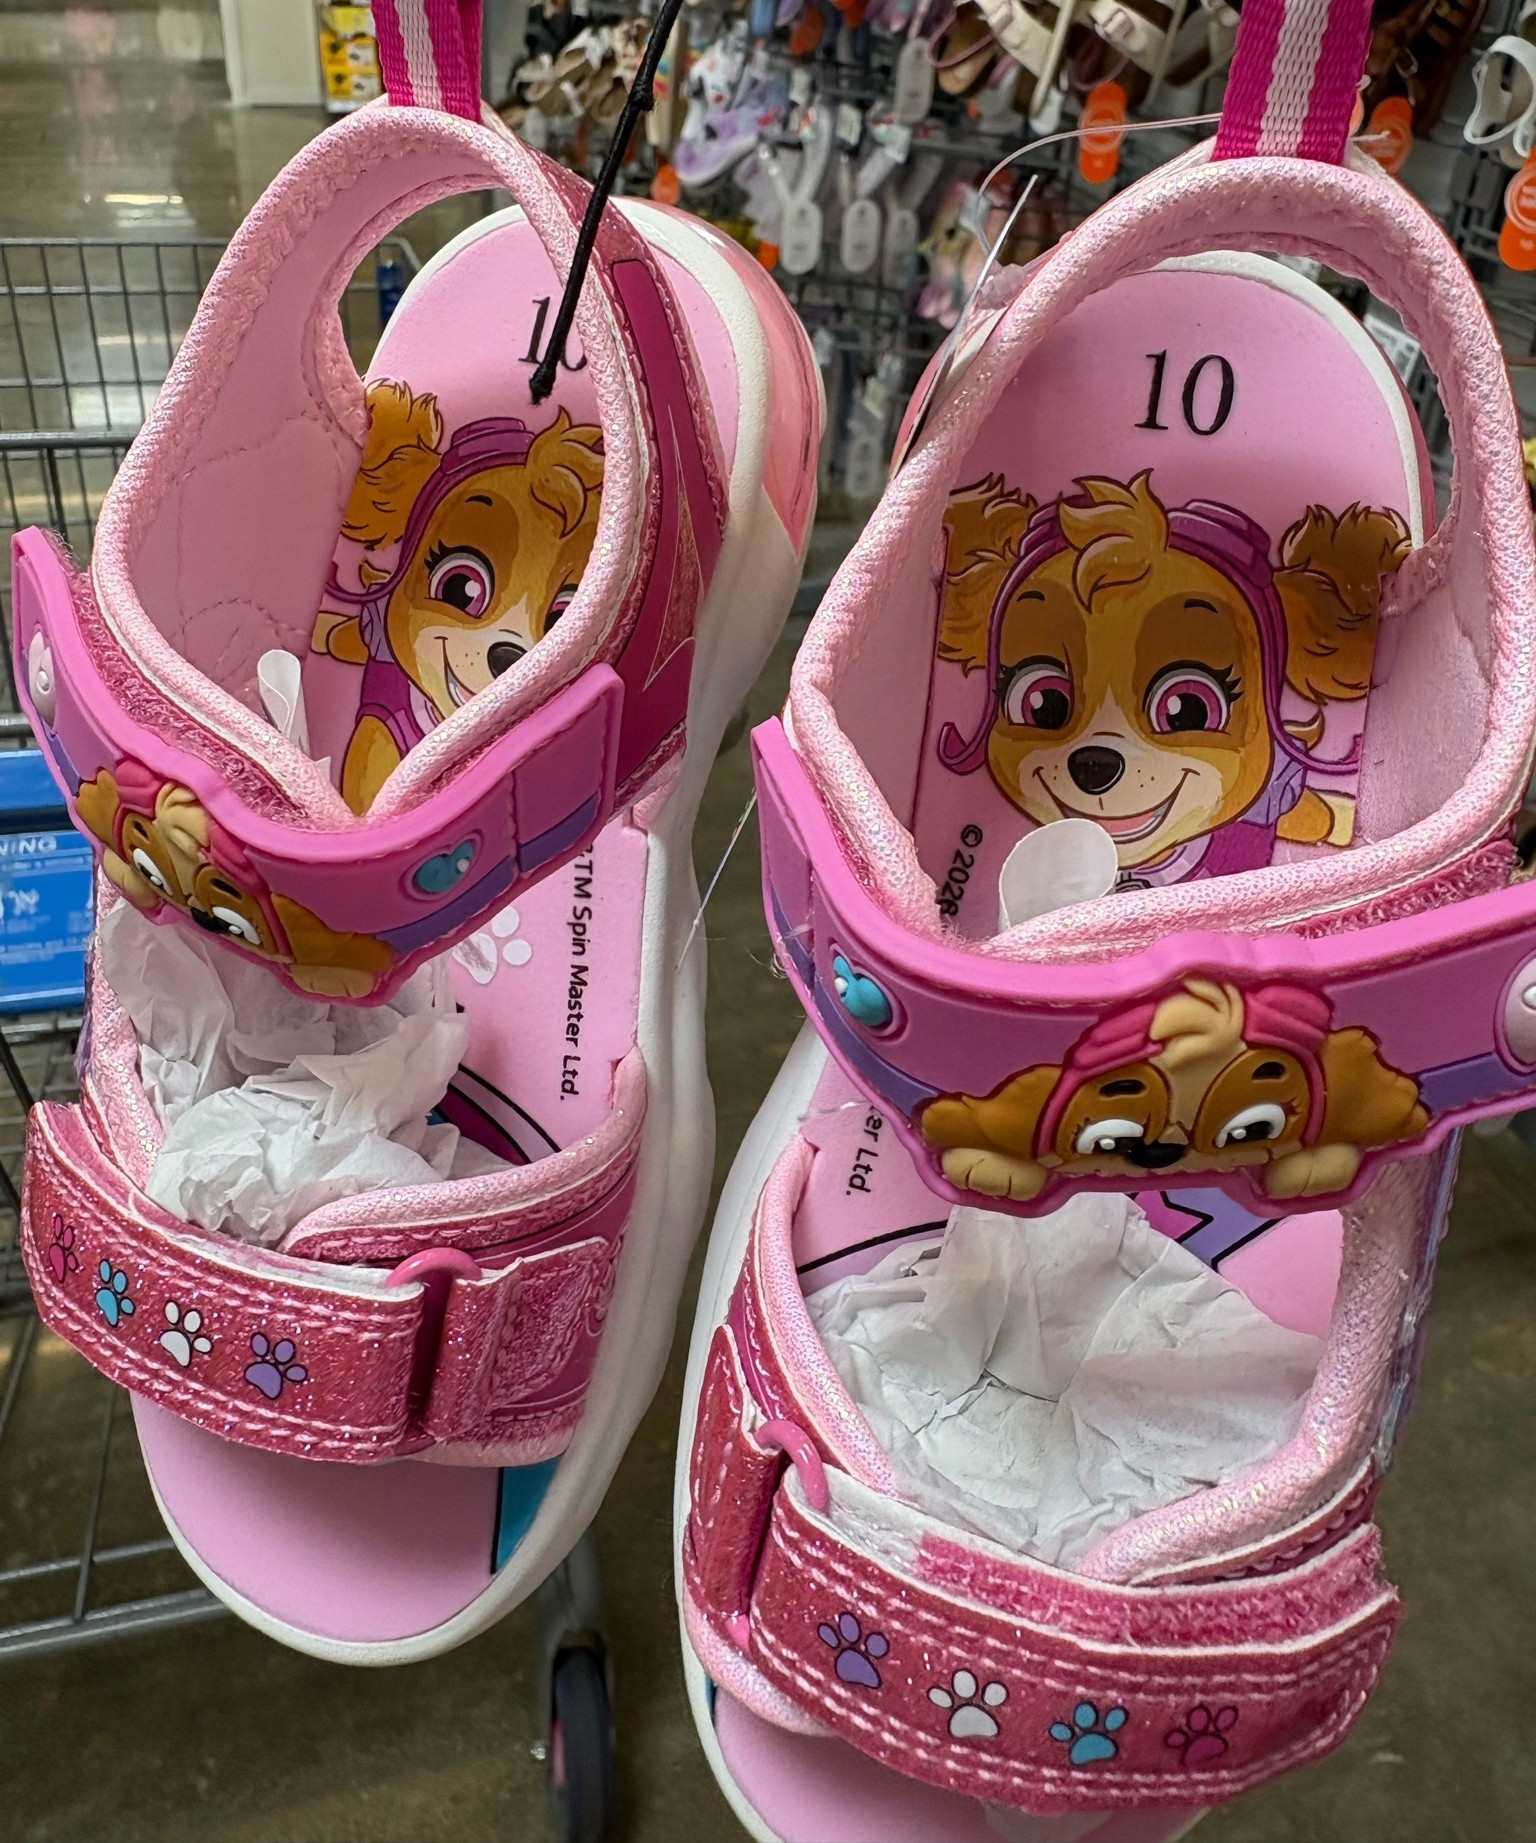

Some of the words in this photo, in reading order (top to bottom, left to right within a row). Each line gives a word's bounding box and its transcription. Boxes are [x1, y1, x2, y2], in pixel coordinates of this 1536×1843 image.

[1134, 349, 1235, 436] 10
[573, 860, 593, 899] TM
[566, 905, 593, 956] Spin
[565, 964, 590, 1048] Master
[560, 1054, 582, 1100] Ltd.
[846, 1147, 879, 1196] Ltd.
